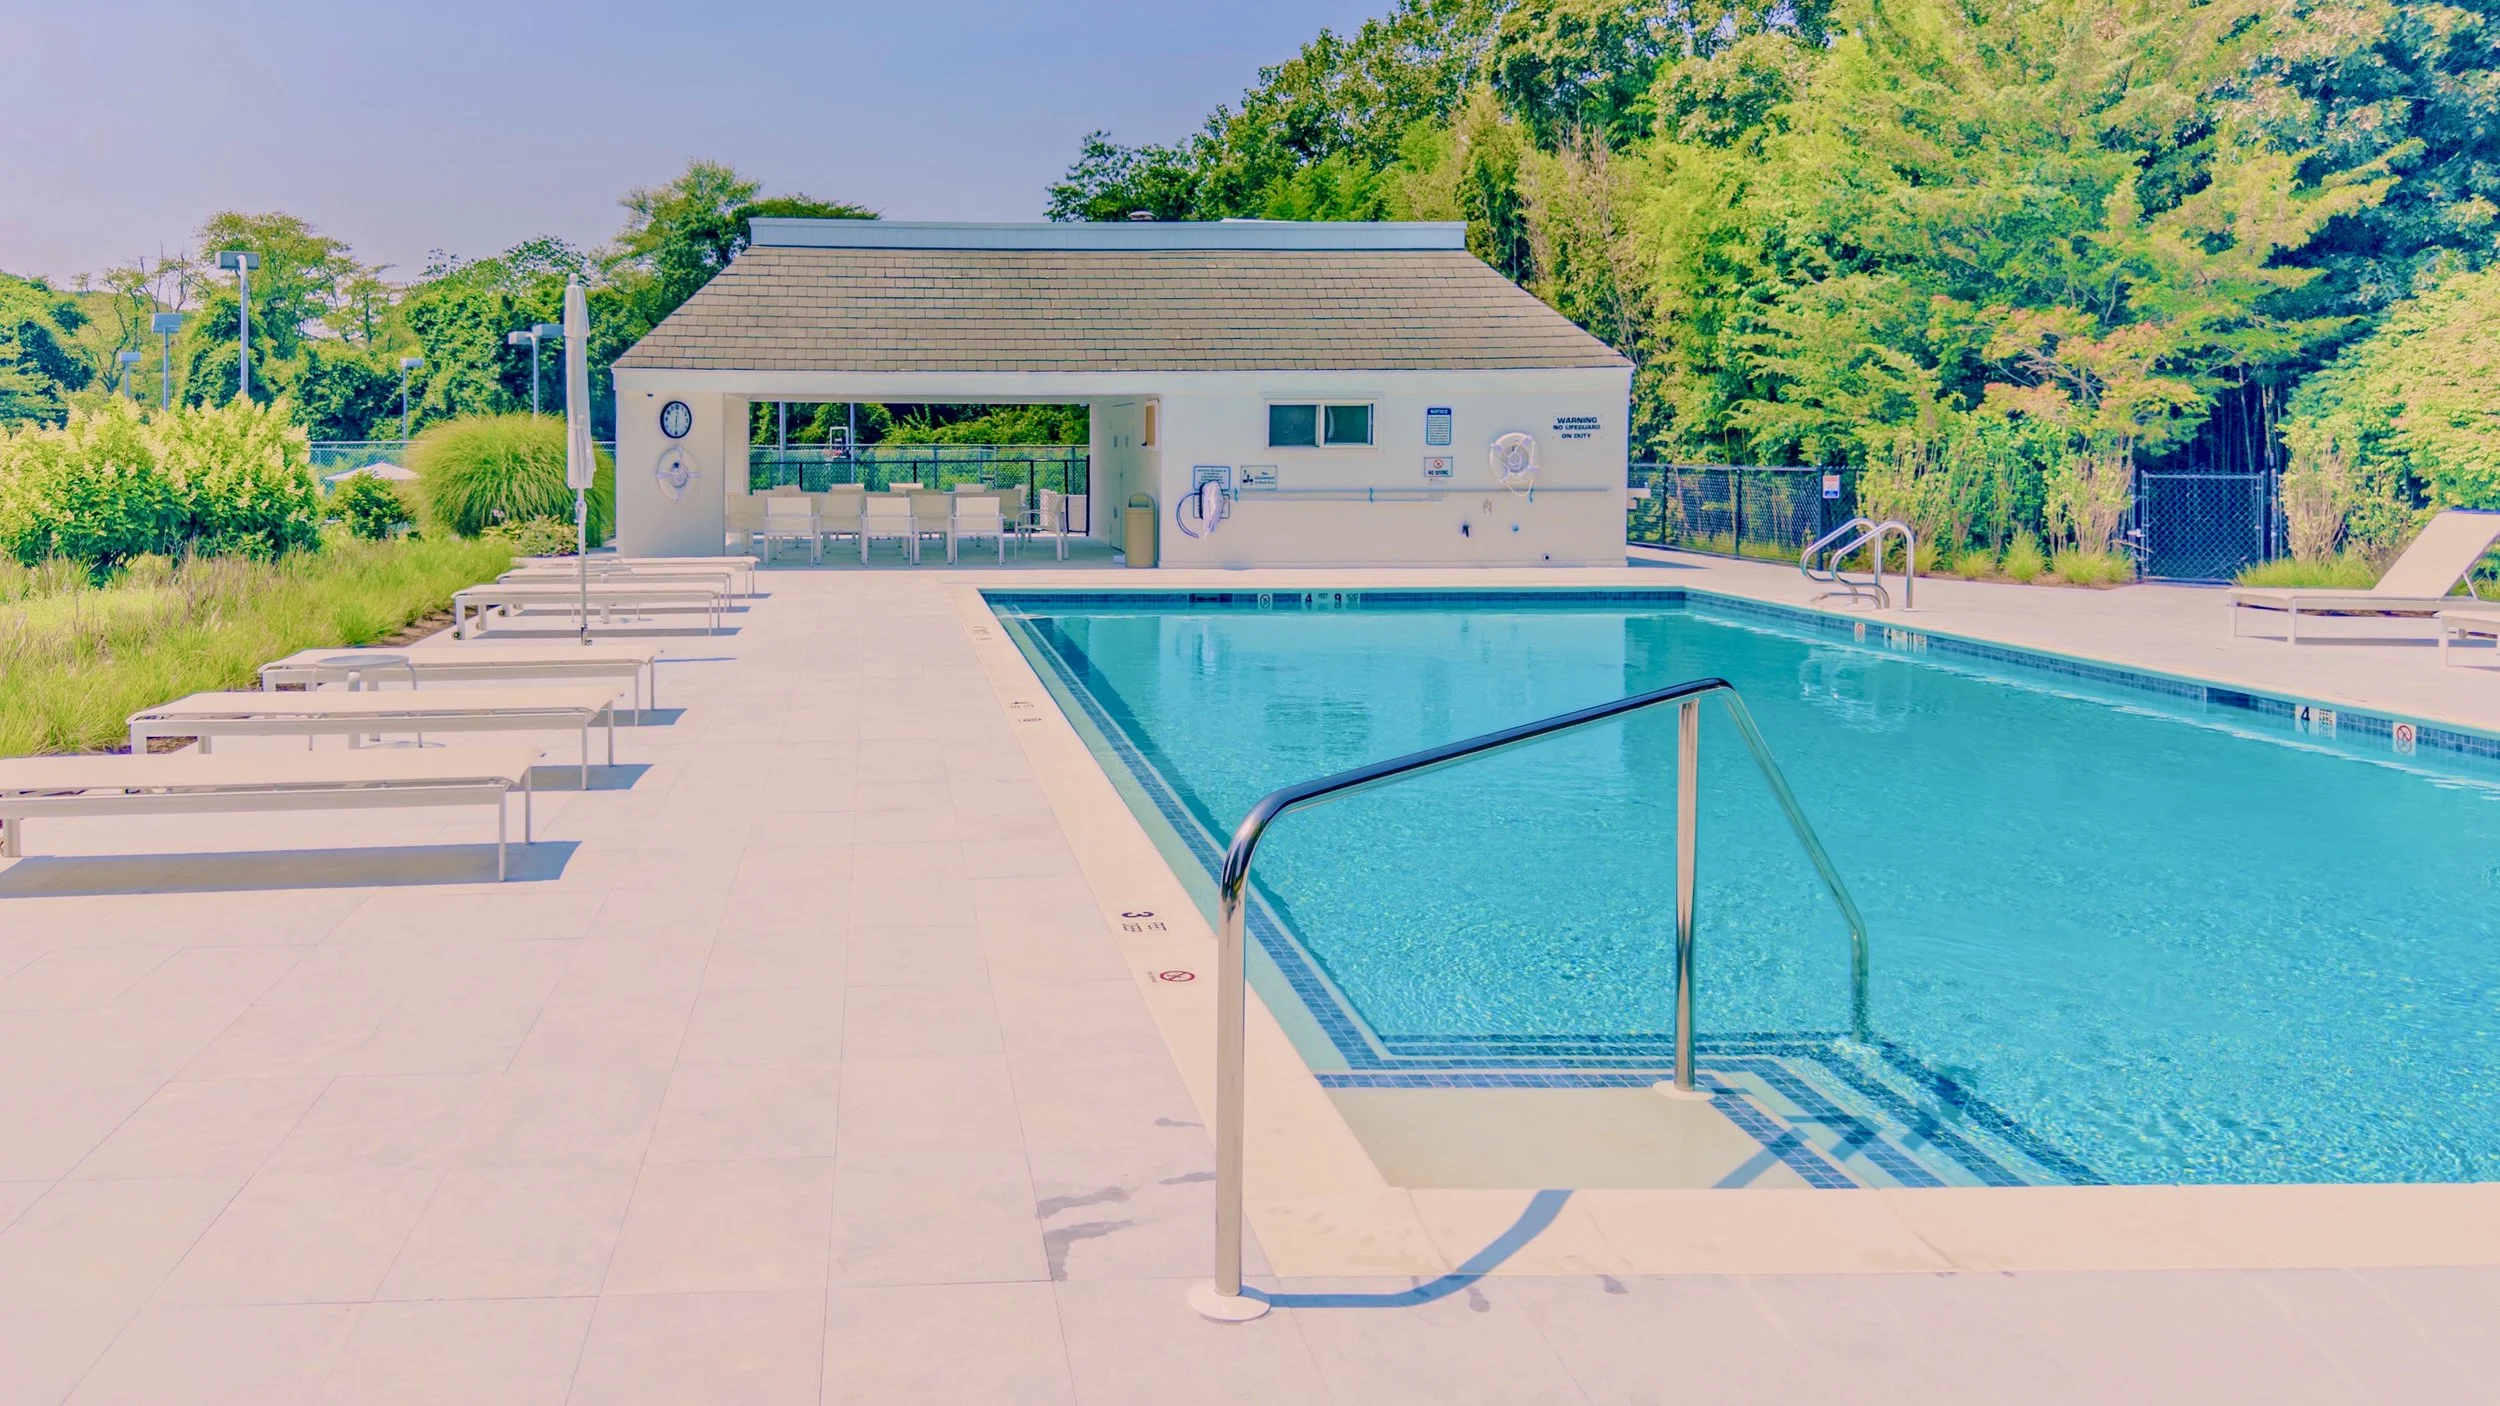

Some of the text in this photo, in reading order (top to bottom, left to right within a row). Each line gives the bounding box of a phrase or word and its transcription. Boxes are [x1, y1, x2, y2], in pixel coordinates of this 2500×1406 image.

[1305, 593, 1312, 602] 4
[2301, 706, 2311, 721] 4
[1121, 911, 1155, 919] 3
